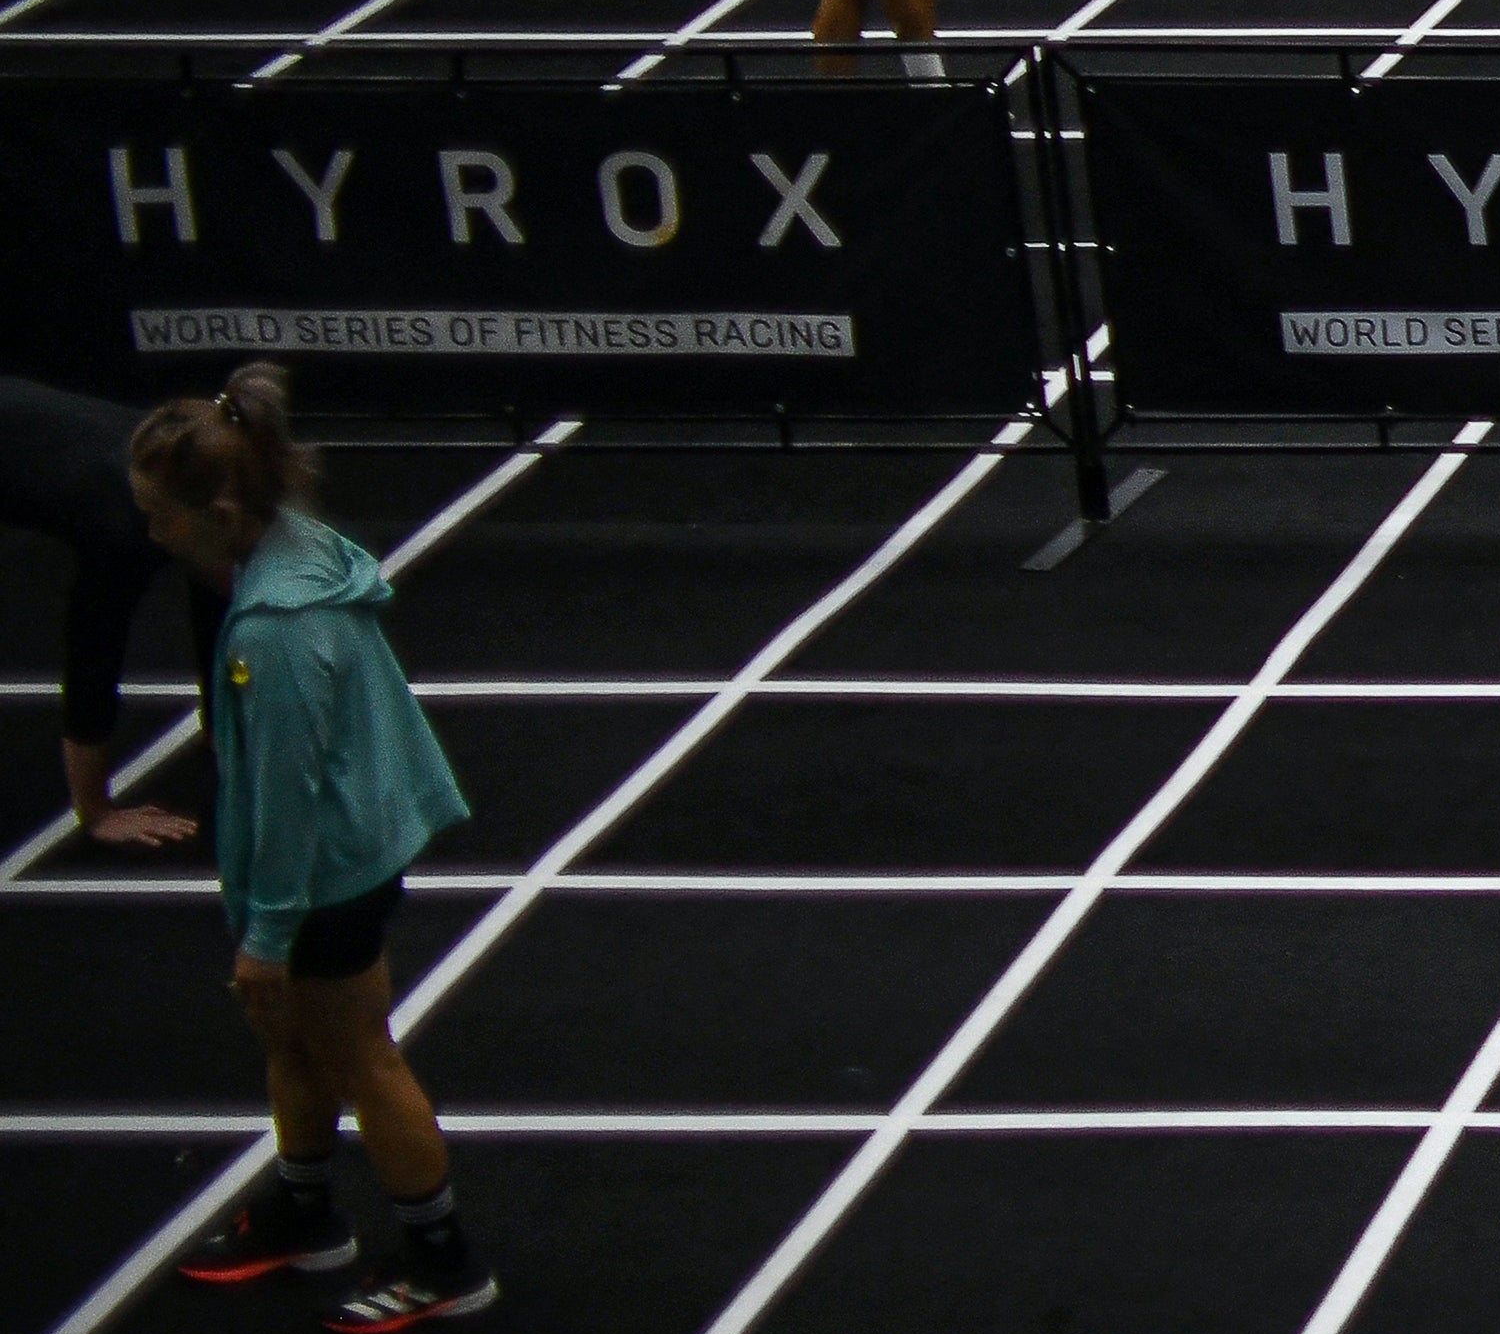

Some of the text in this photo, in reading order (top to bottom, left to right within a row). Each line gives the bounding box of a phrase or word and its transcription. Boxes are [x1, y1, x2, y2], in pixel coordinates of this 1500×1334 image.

[110, 147, 842, 248] HYROX
[136, 314, 841, 349] WORLD SERIES OF FITNESS RACING
[1288, 317, 1429, 348] WORLD
